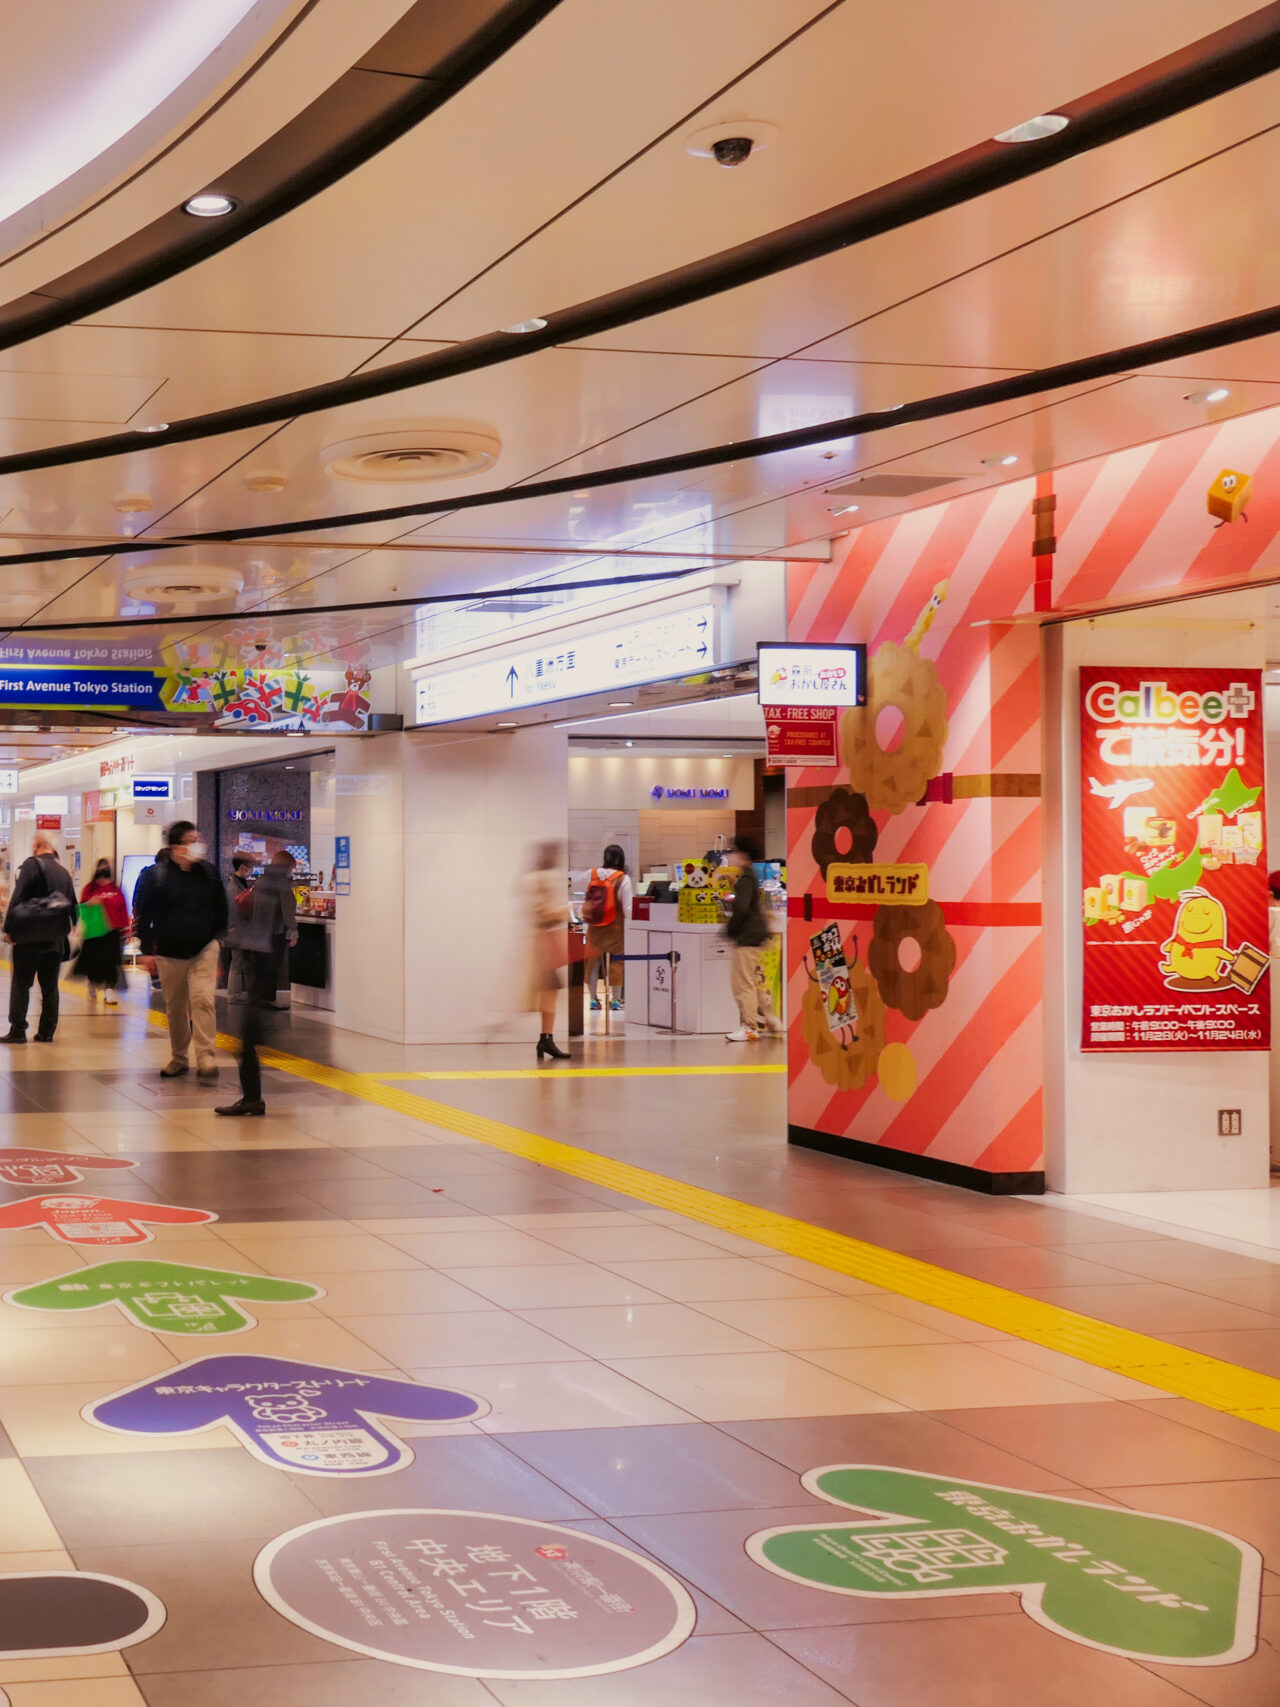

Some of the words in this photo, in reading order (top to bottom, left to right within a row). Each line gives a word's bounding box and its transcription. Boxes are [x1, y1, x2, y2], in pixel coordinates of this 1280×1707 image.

[26, 680, 71, 692] Avenue
[73, 681, 109, 694] Tokyo
[111, 682, 153, 694] Station
[765, 707, 782, 719] TAX
[787, 708, 809, 719] FREE
[810, 708, 835, 720] SHOP
[833, 873, 920, 895] 東京おかしランド
[1090, 1004, 1261, 1017] 東京おかしランドイベントスペース
[154, 1378, 371, 1395] 東京キャラクターストリート
[933, 1489, 1210, 1612] 東京おかしランド
[368, 1559, 388, 1569] B1
[379, 1570, 415, 1599] Central
[406, 1599, 431, 1619] Area
[372, 1541, 398, 1559] First
[389, 1559, 422, 1585] Avenue
[417, 1585, 444, 1609] Tokyo
[439, 1609, 475, 1639] Station
[405, 1539, 534, 1635] 中央エリア
[464, 1544, 579, 1620] 地下1階
